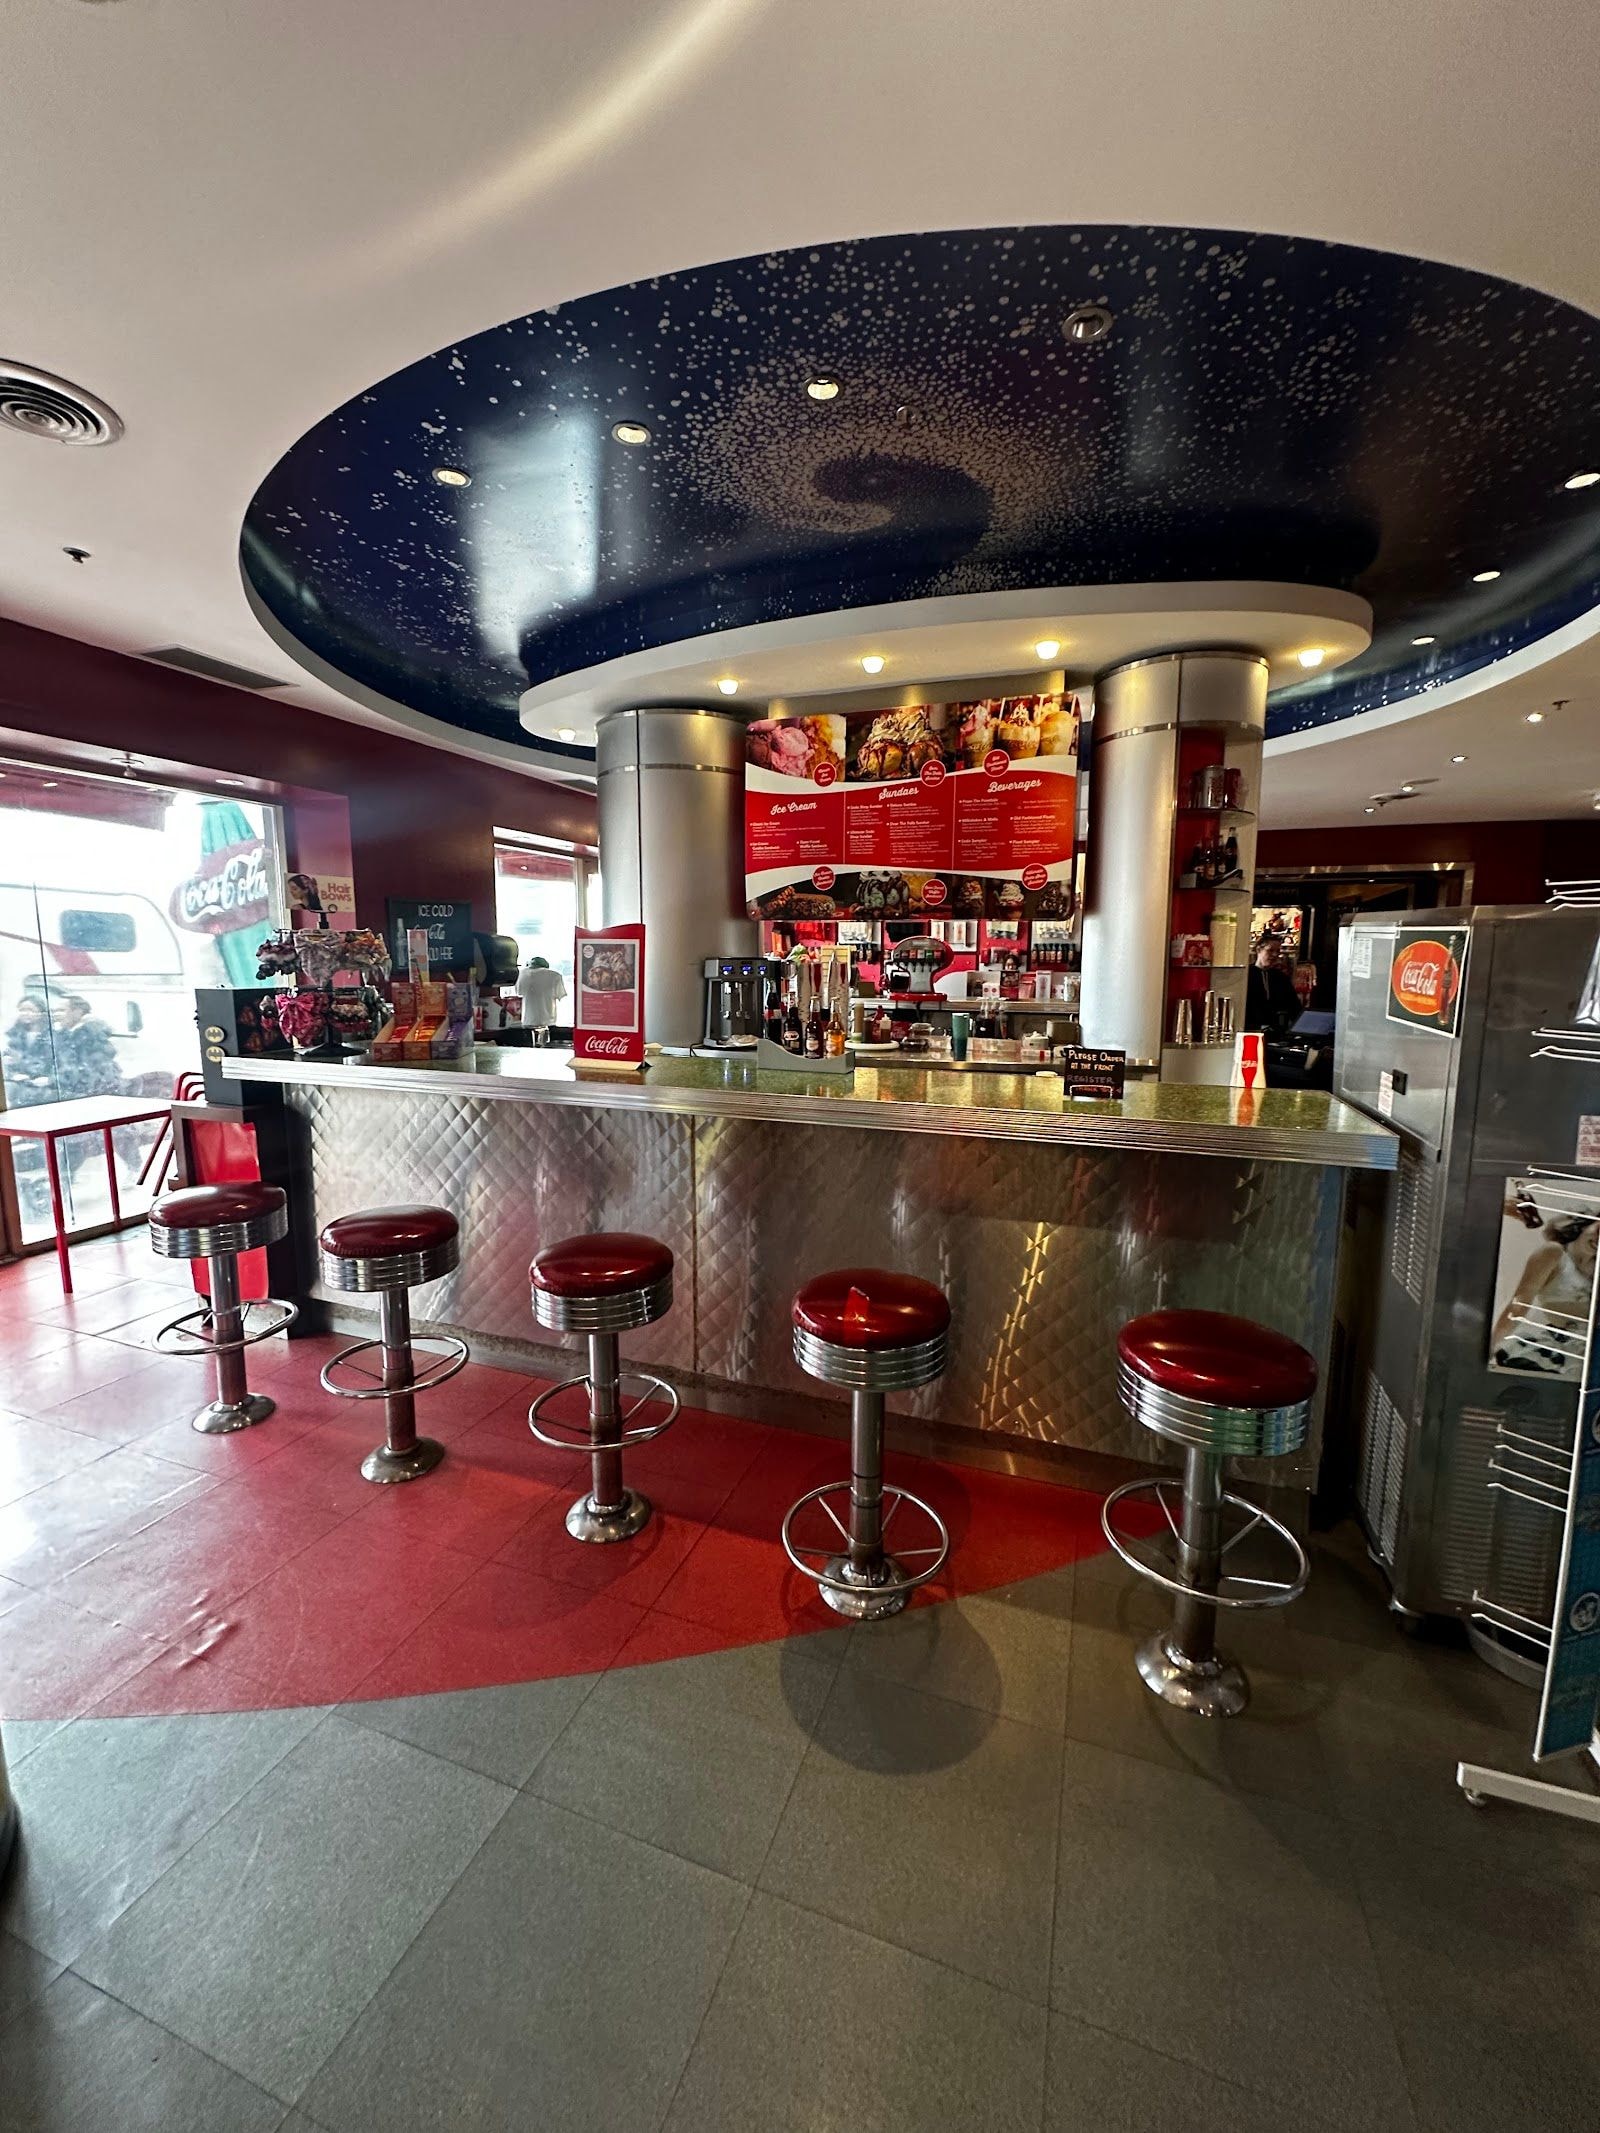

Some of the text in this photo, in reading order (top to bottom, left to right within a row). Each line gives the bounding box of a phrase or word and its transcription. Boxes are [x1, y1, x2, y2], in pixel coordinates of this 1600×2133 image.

[987, 778, 1042, 793] Beverages
[878, 787, 919, 801] Sundaes
[770, 801, 818, 815] Ice Cream
[328, 882, 351, 894] Hair
[320, 890, 352, 902] Bows
[418, 904, 454, 917] ICE COLD
[585, 1035, 630, 1055] Coca-Cola
[1068, 1050, 1125, 1063] PLEASE ORDER
[1070, 1062, 1078, 1070] AT
[1094, 1064, 1116, 1072] FRONT
[1067, 1075, 1115, 1085] REGISTER
